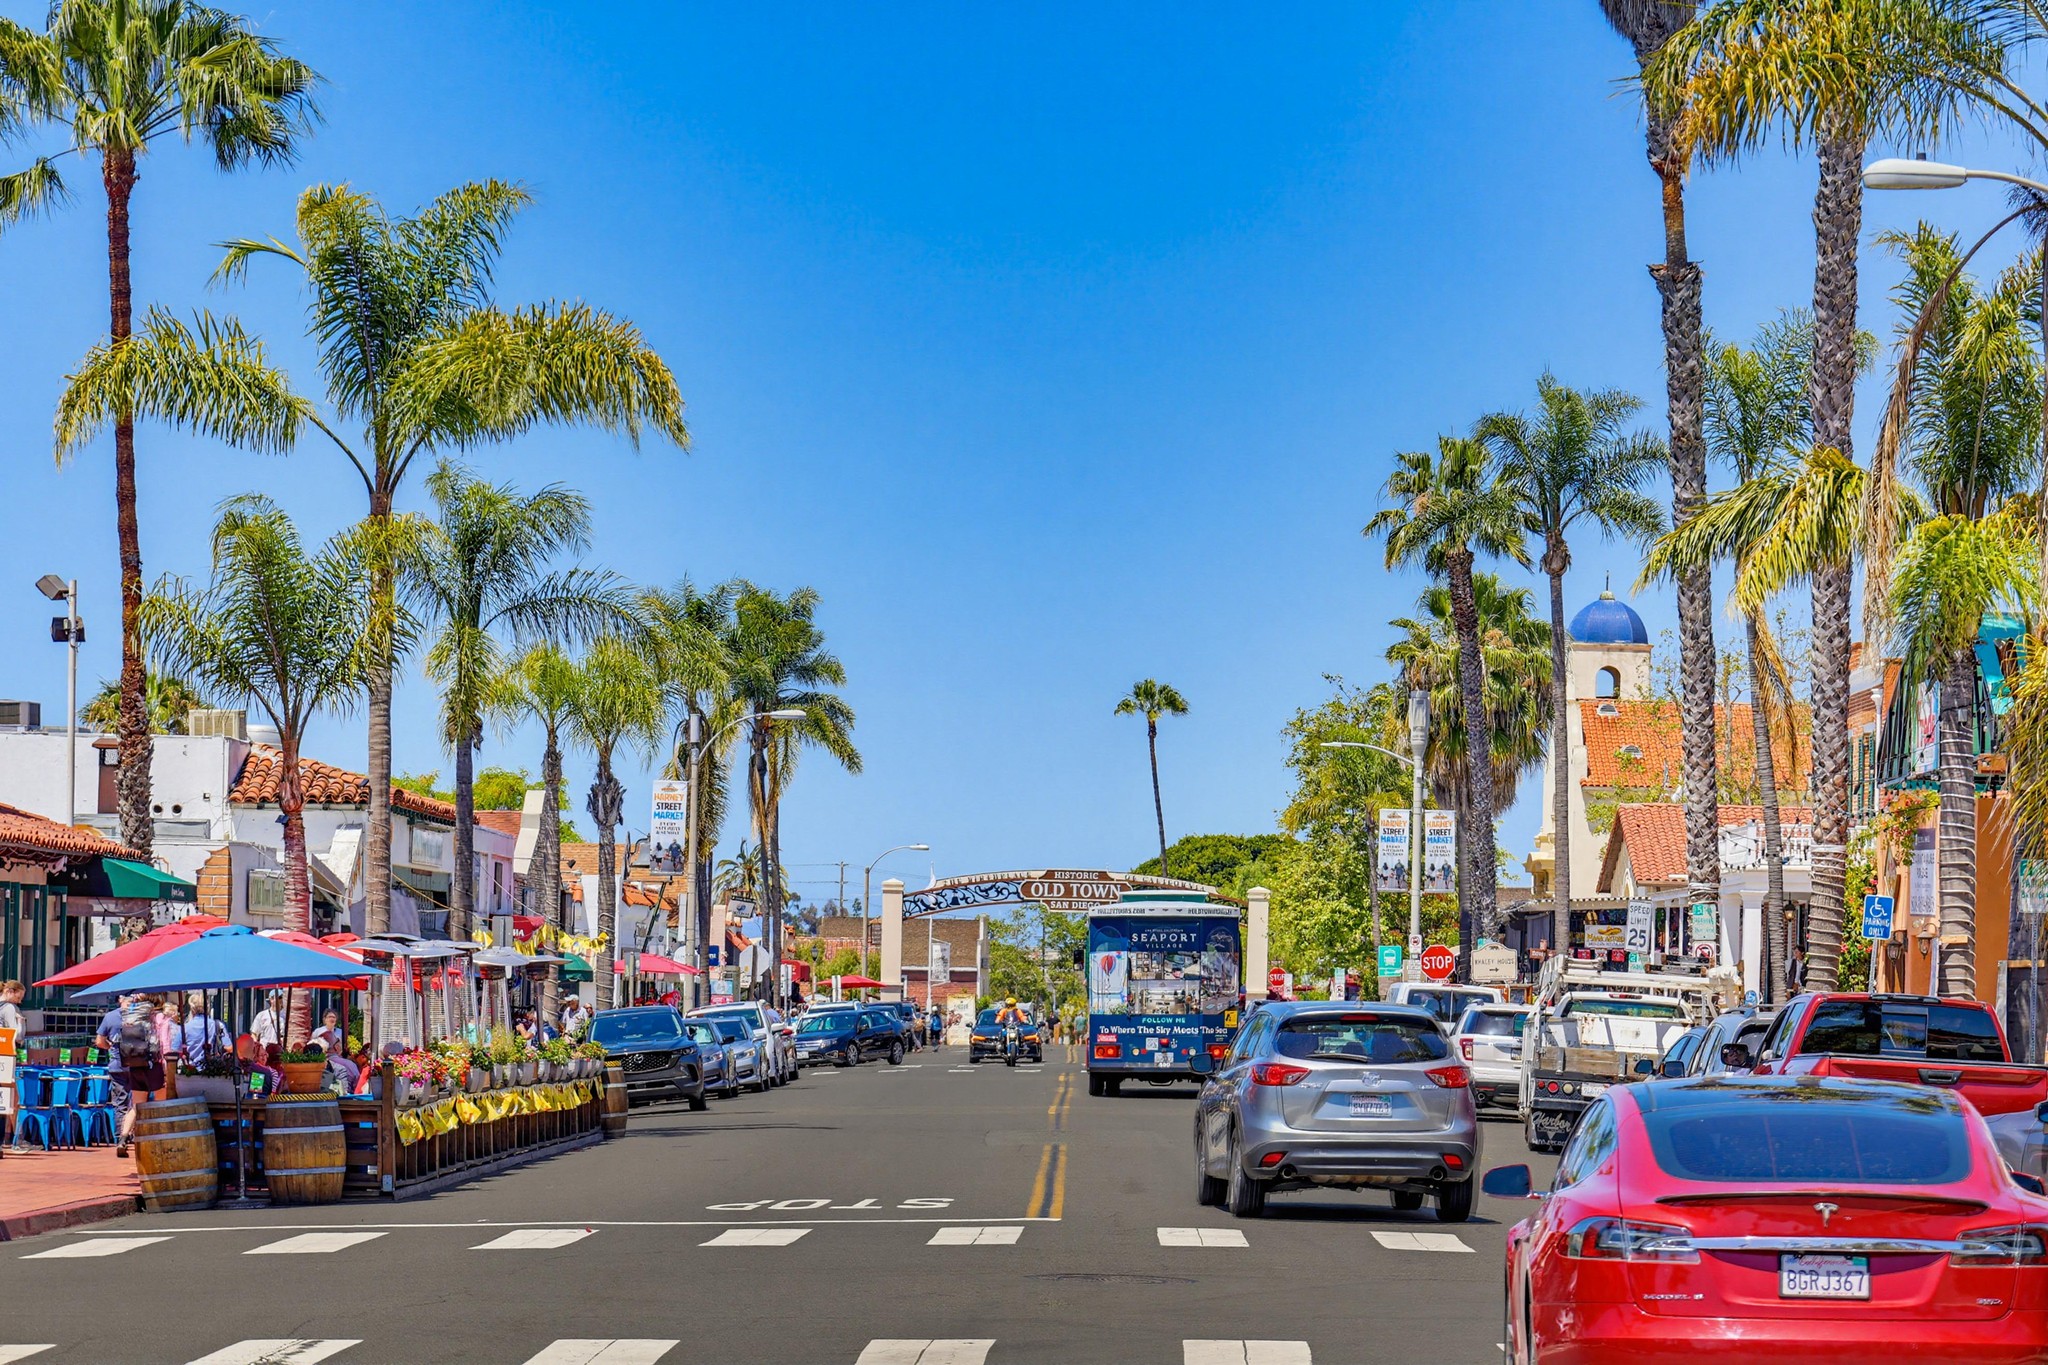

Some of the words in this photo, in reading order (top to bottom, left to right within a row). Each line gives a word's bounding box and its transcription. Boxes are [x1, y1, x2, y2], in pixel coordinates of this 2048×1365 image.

[654, 793, 684, 801] HARNEY
[656, 802, 682, 810] STREET
[653, 811, 683, 820] MARKET
[1382, 828, 1405, 836] STREET
[1428, 828, 1451, 836] STREET
[1427, 836, 1453, 844] MARKET
[1054, 871, 1099, 880] HISTORIC
[1030, 882, 1065, 897] OLD
[1070, 883, 1121, 899] TOWN
[1050, 900, 1069, 909] SAN
[1629, 905, 1650, 915] SPEED
[1630, 917, 1648, 926] LIMIT
[1864, 917, 1890, 928] PARKING
[1868, 927, 1885, 937] ONLY
[1131, 933, 1197, 942] SEAPORT
[1628, 928, 1647, 948] 25
[1423, 956, 1452, 970] STOP
[1100, 1026, 1109, 1034] To
[1110, 1026, 1136, 1034] Where
[1137, 1026, 1154, 1034] The
[1156, 1026, 1171, 1035] Sky
[1172, 1026, 1199, 1034] Meets
[1200, 1026, 1214, 1034] The
[1532, 1111, 1571, 1132] Harbor
[706, 1198, 954, 1210] STOP
[1787, 1269, 1865, 1292] 8GRJ367
